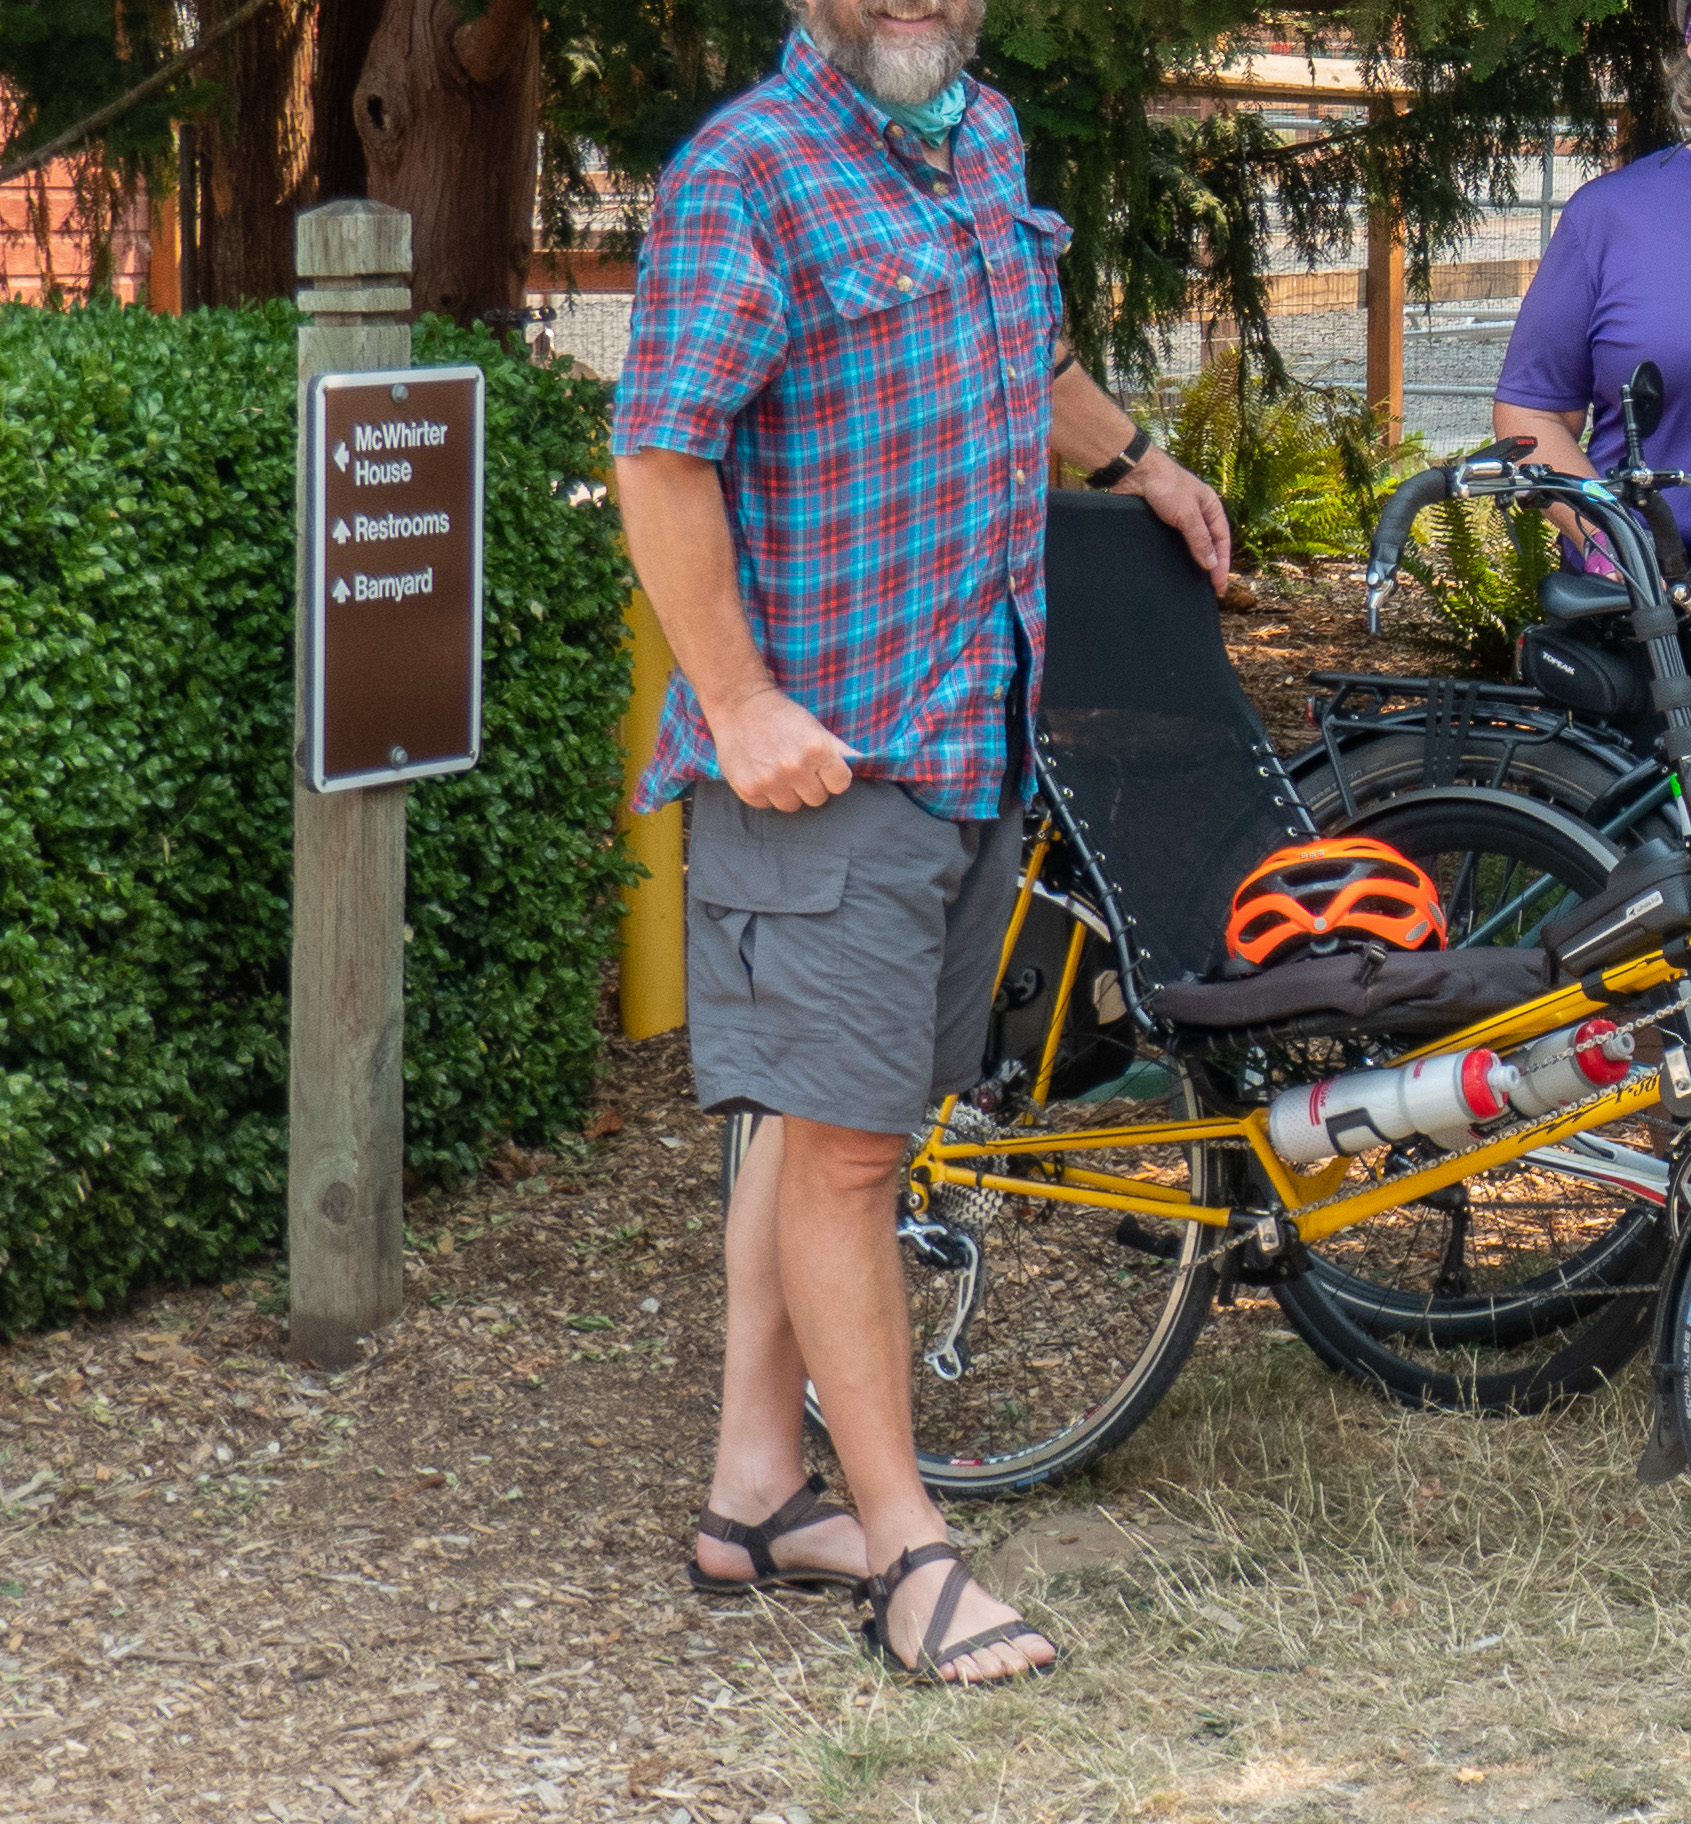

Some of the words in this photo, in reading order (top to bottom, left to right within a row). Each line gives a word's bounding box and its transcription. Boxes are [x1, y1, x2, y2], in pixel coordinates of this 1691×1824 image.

[355, 421, 448, 451] McWhirter
[355, 460, 412, 486] House
[355, 512, 450, 543] Restrooms
[355, 567, 433, 602] Barnyard
